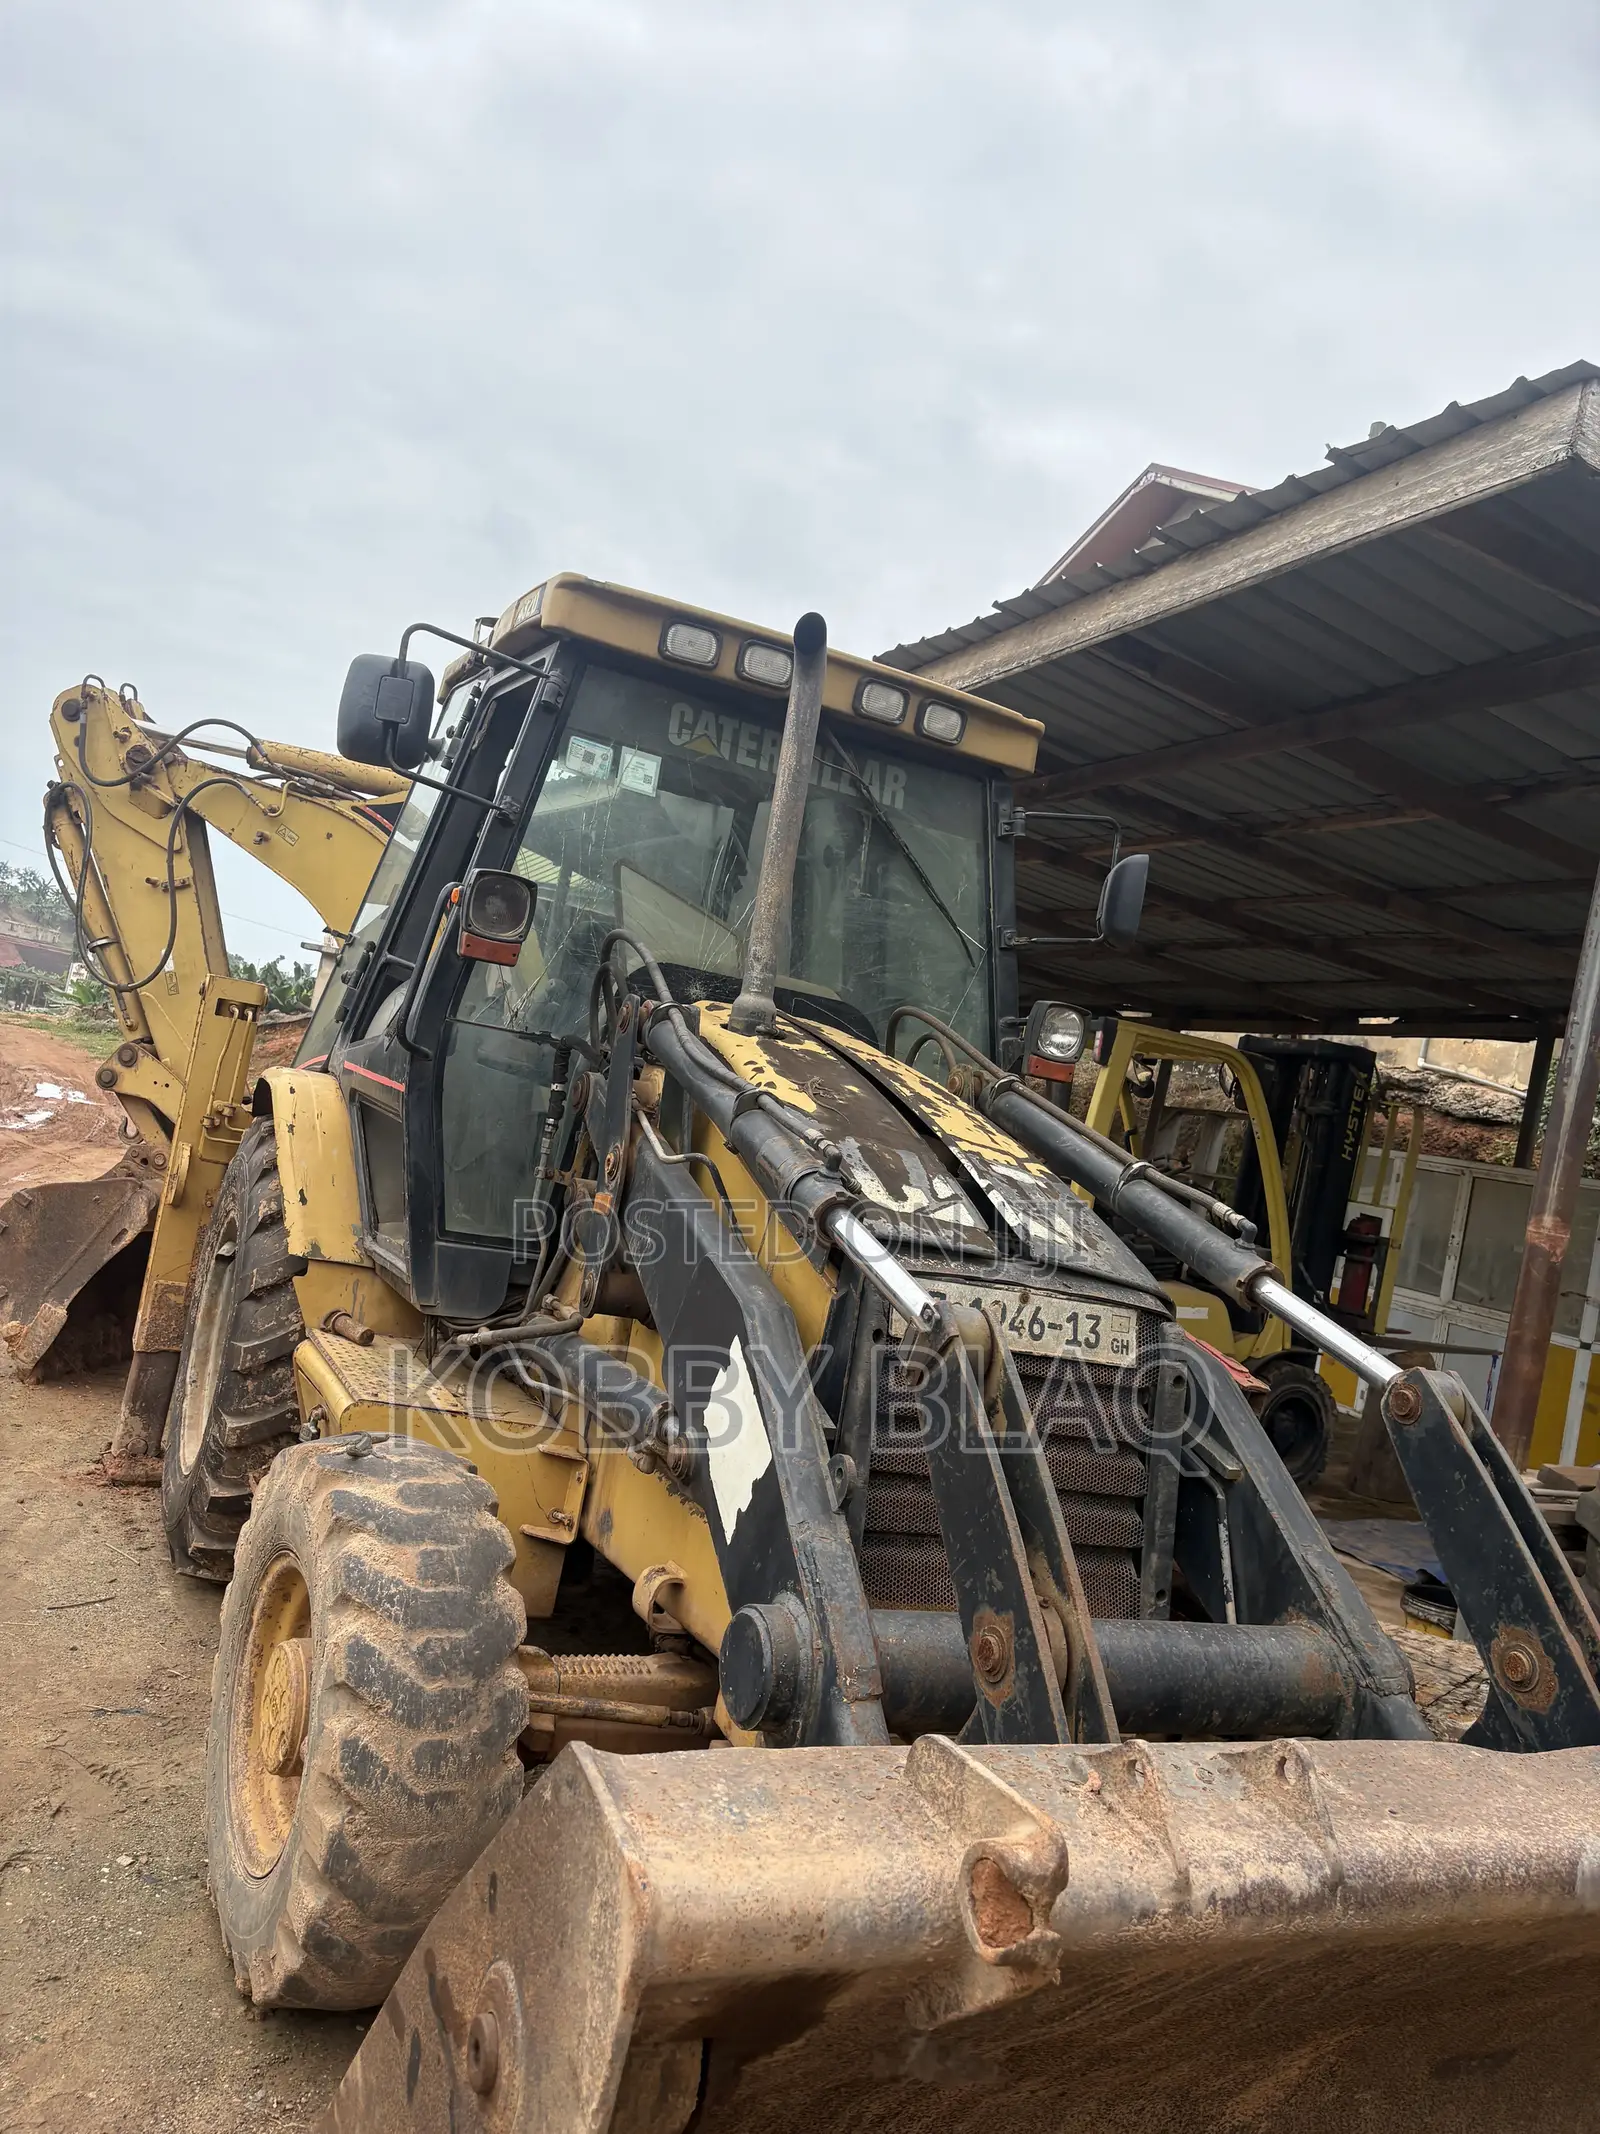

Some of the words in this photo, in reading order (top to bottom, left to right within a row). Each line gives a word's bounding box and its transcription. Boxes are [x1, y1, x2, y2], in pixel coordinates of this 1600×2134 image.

[667, 701, 908, 810] CATERILLAR
[969, 1297, 1102, 1350] 46-13
[1110, 1337, 1130, 1356] GH
